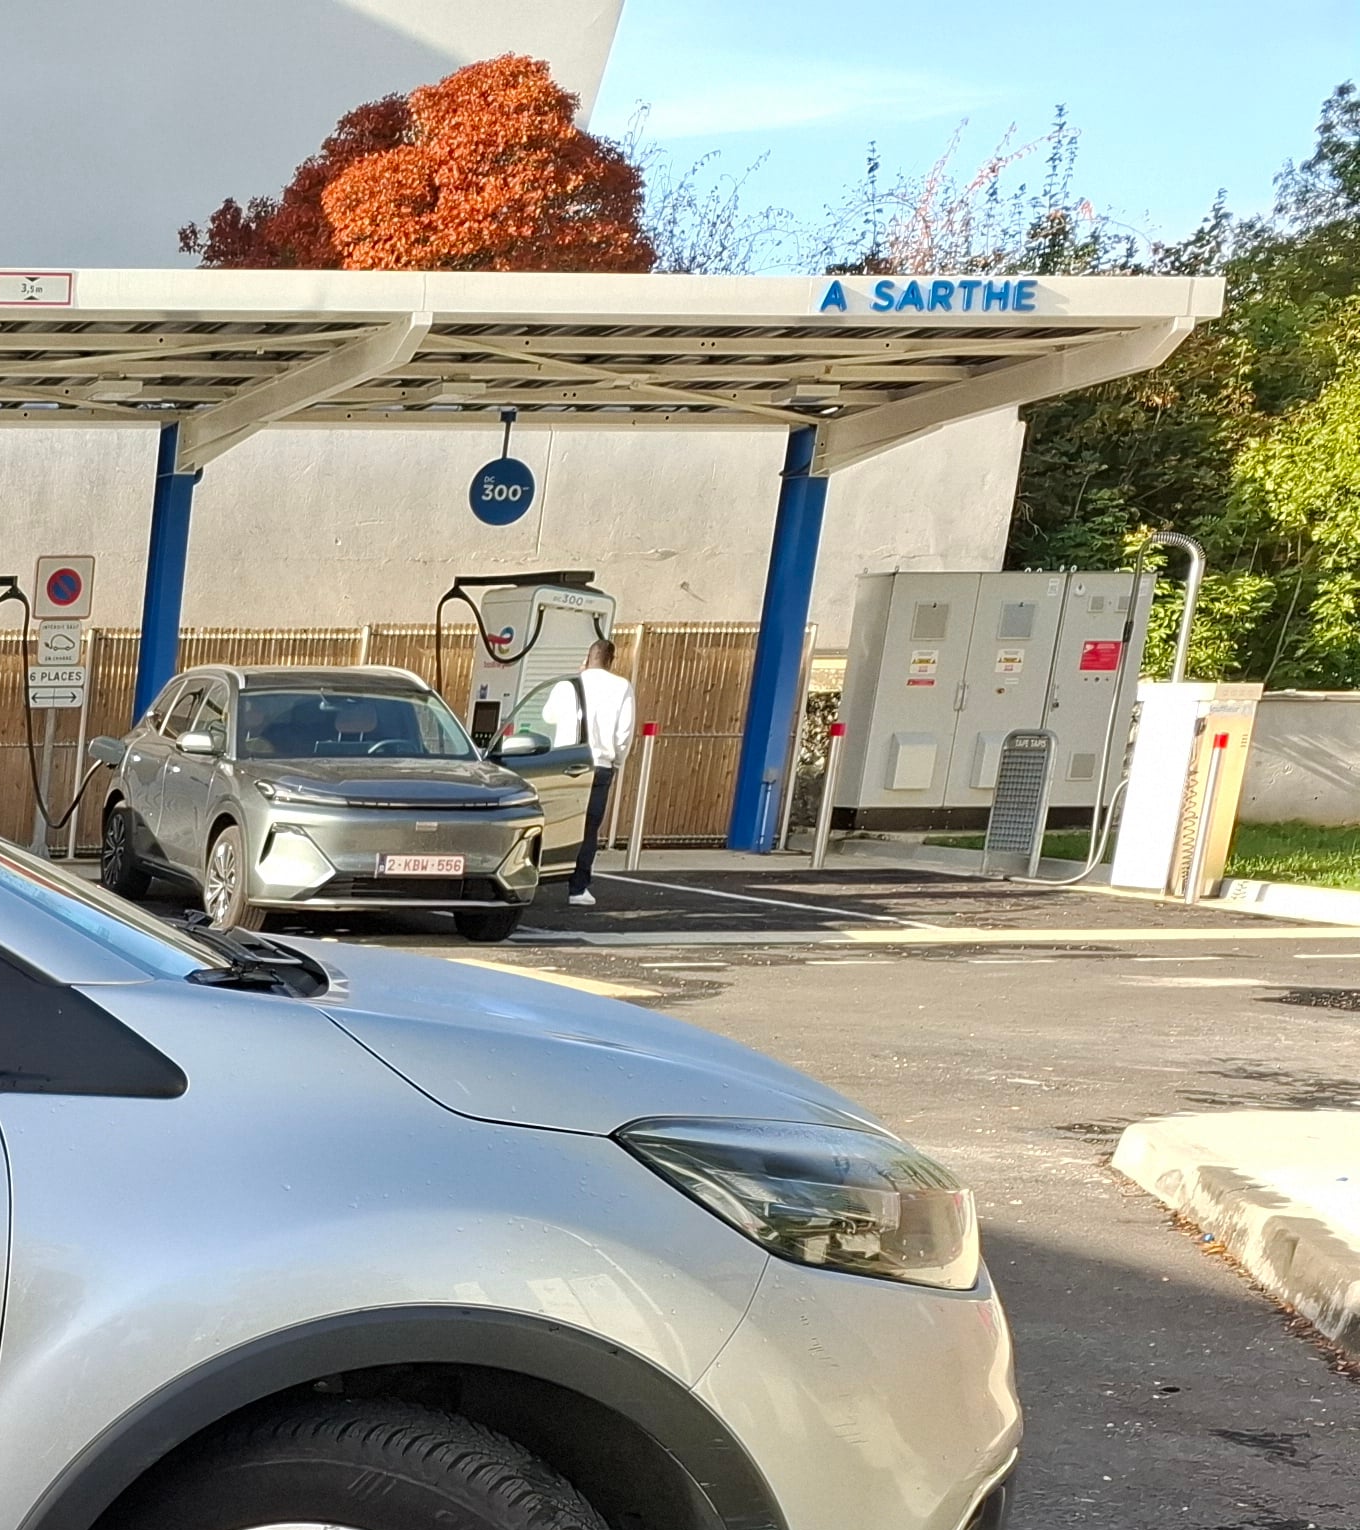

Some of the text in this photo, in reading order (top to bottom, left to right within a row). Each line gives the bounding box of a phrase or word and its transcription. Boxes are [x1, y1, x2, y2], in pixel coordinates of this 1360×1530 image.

[819, 279, 1038, 312] A SARTHE
[481, 484, 522, 501] 300
[562, 593, 584, 606] 300
[30, 671, 82, 681] 6 PLACES
